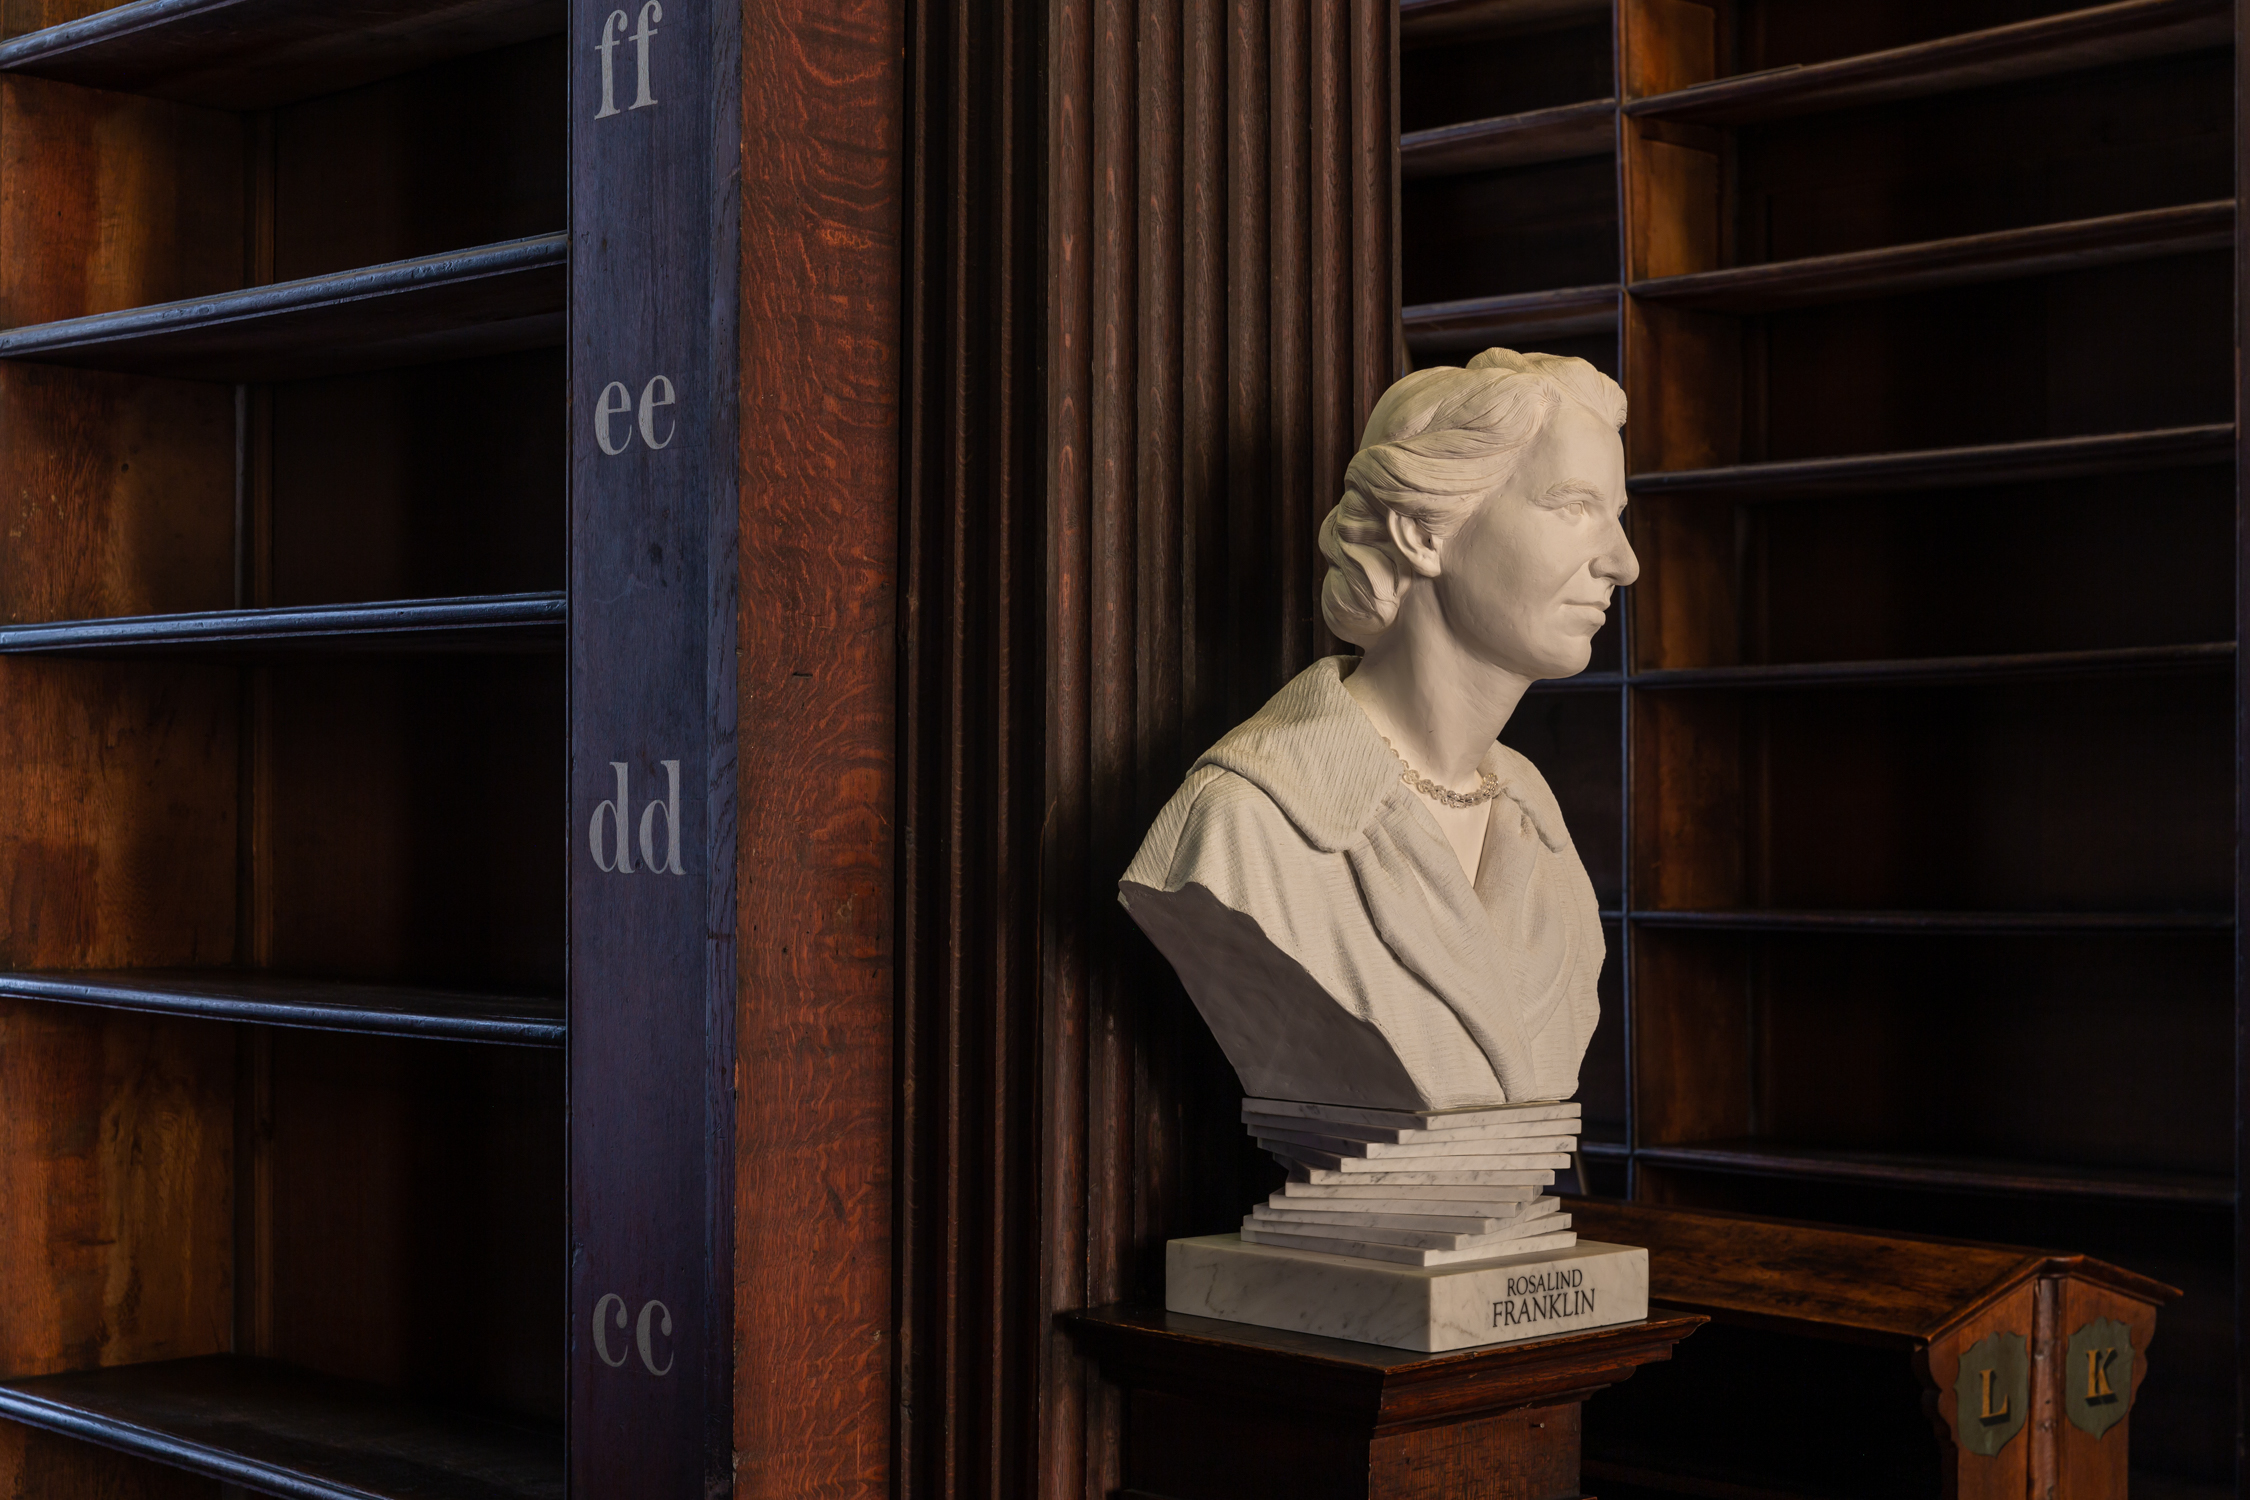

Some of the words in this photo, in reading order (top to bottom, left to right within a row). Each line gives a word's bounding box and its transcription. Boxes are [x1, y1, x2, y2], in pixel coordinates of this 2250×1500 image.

[593, 0, 663, 120] ff
[594, 374, 676, 456] ee
[588, 759, 687, 876] dd
[1492, 1288, 1595, 1328] FRANKLIN
[1507, 1268, 1583, 1297] ROSALIND
[592, 1292, 674, 1376] cc
[1979, 1368, 2009, 1422] L
[2085, 1347, 2116, 1402] K
